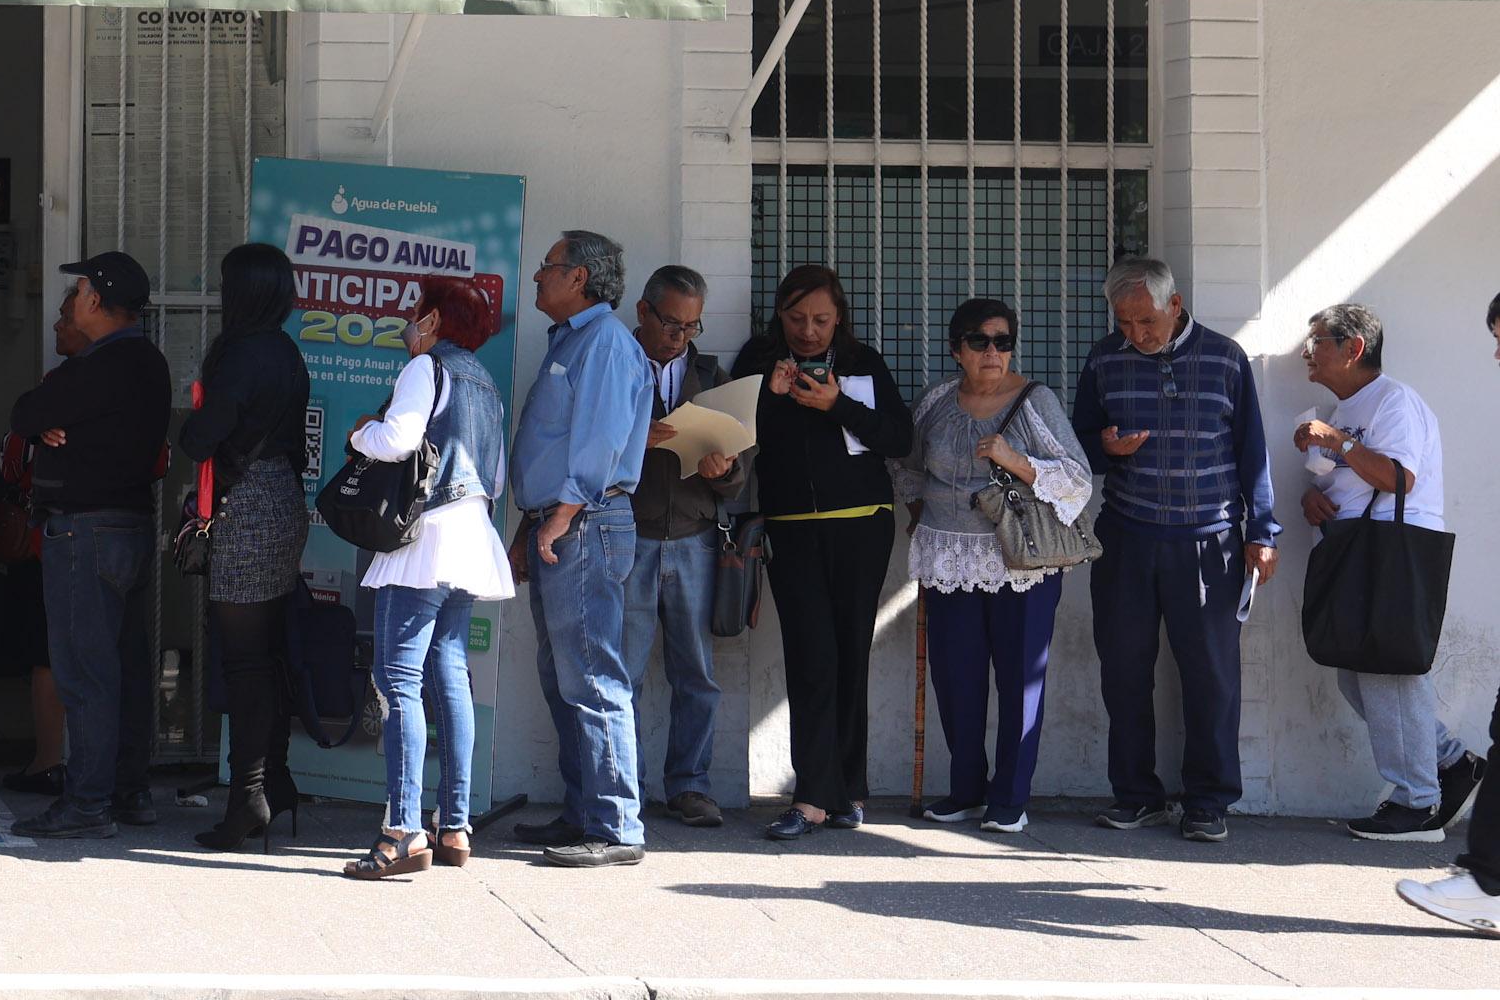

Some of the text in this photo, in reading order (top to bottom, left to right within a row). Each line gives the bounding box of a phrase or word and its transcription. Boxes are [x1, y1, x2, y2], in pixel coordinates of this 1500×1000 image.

[351, 196, 437, 214] Agua de Puebla
[296, 225, 471, 271] PAGO ANUAL
[293, 270, 423, 311] NTICIPA
[300, 310, 409, 349] 202
[322, 355, 333, 365] tu
[336, 355, 361, 369] Pago
[364, 358, 394, 370] Anual
[321, 372, 334, 381] en
[337, 371, 347, 382] el
[349, 374, 382, 385] sorteo
